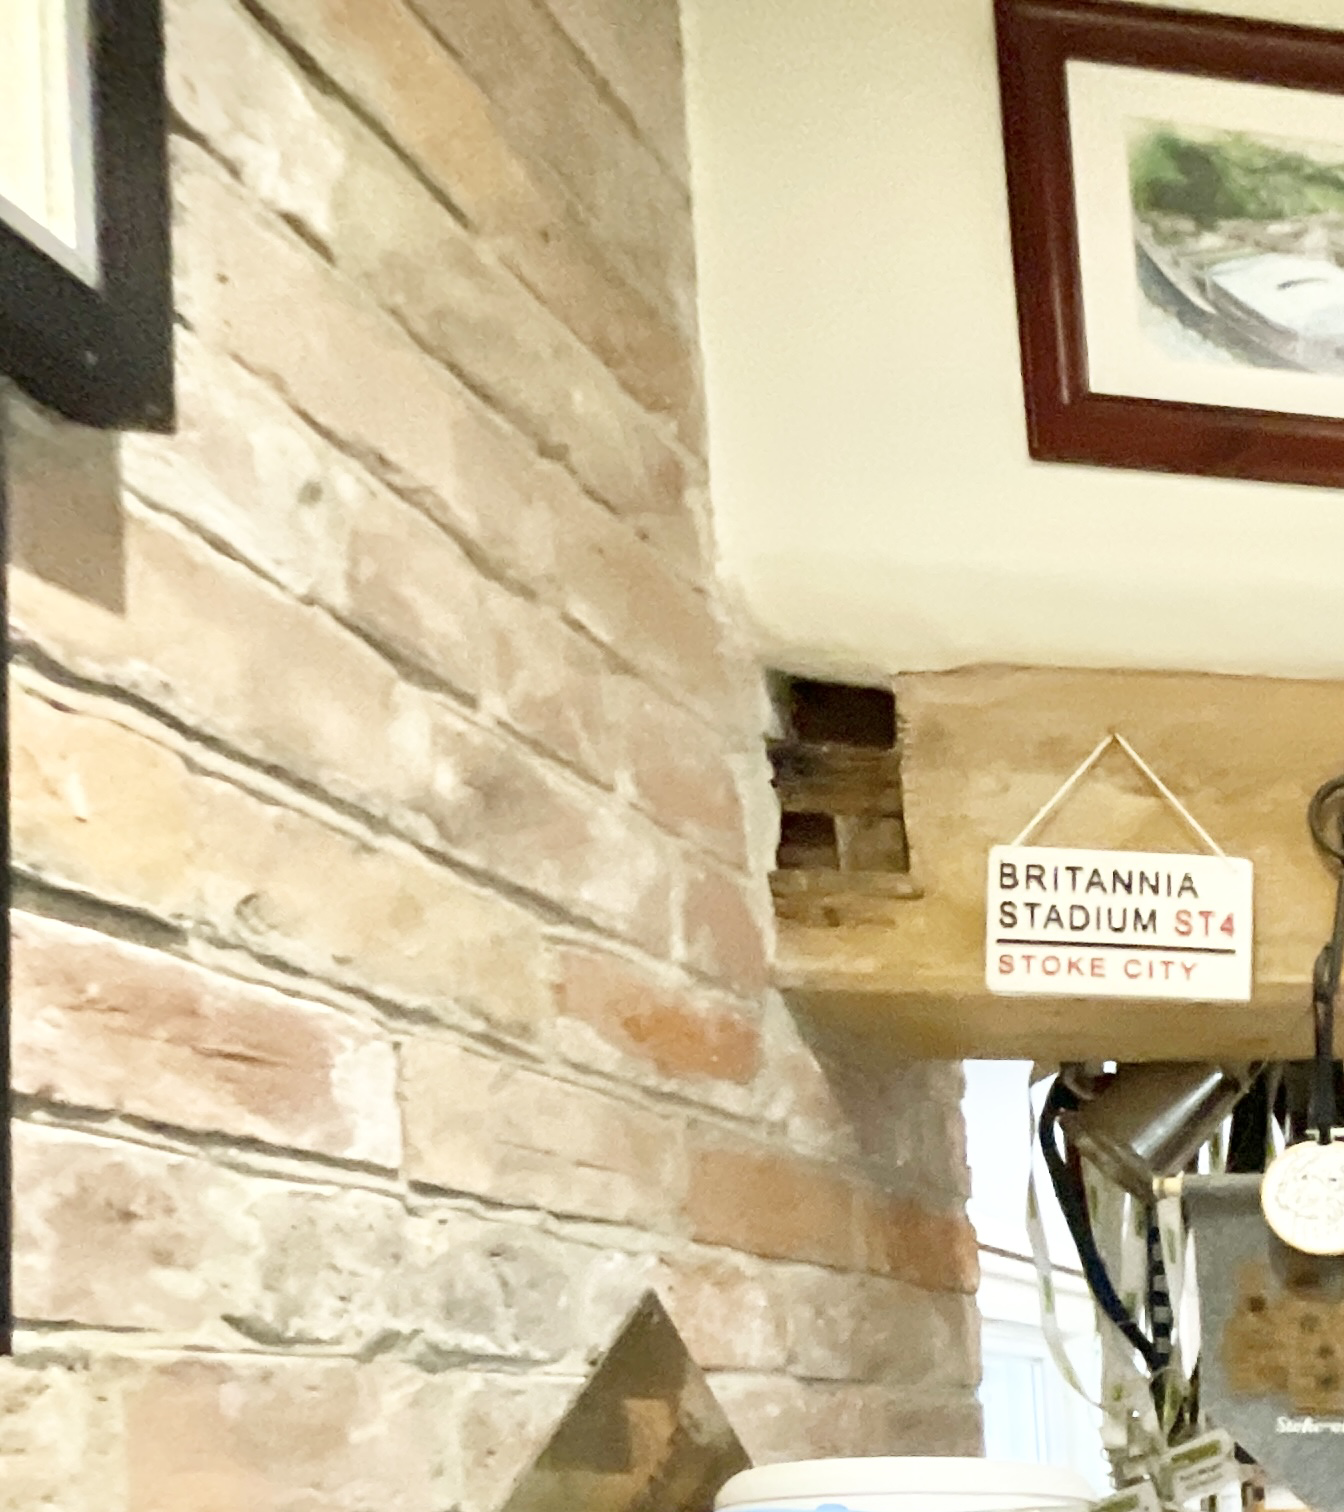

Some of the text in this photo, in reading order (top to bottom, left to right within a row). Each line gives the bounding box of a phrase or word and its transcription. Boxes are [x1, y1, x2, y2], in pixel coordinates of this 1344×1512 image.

[999, 861, 1199, 899] BRITANNIA
[998, 900, 1236, 938] STADIUM ST4
[998, 954, 1198, 981] STOKE CITY
